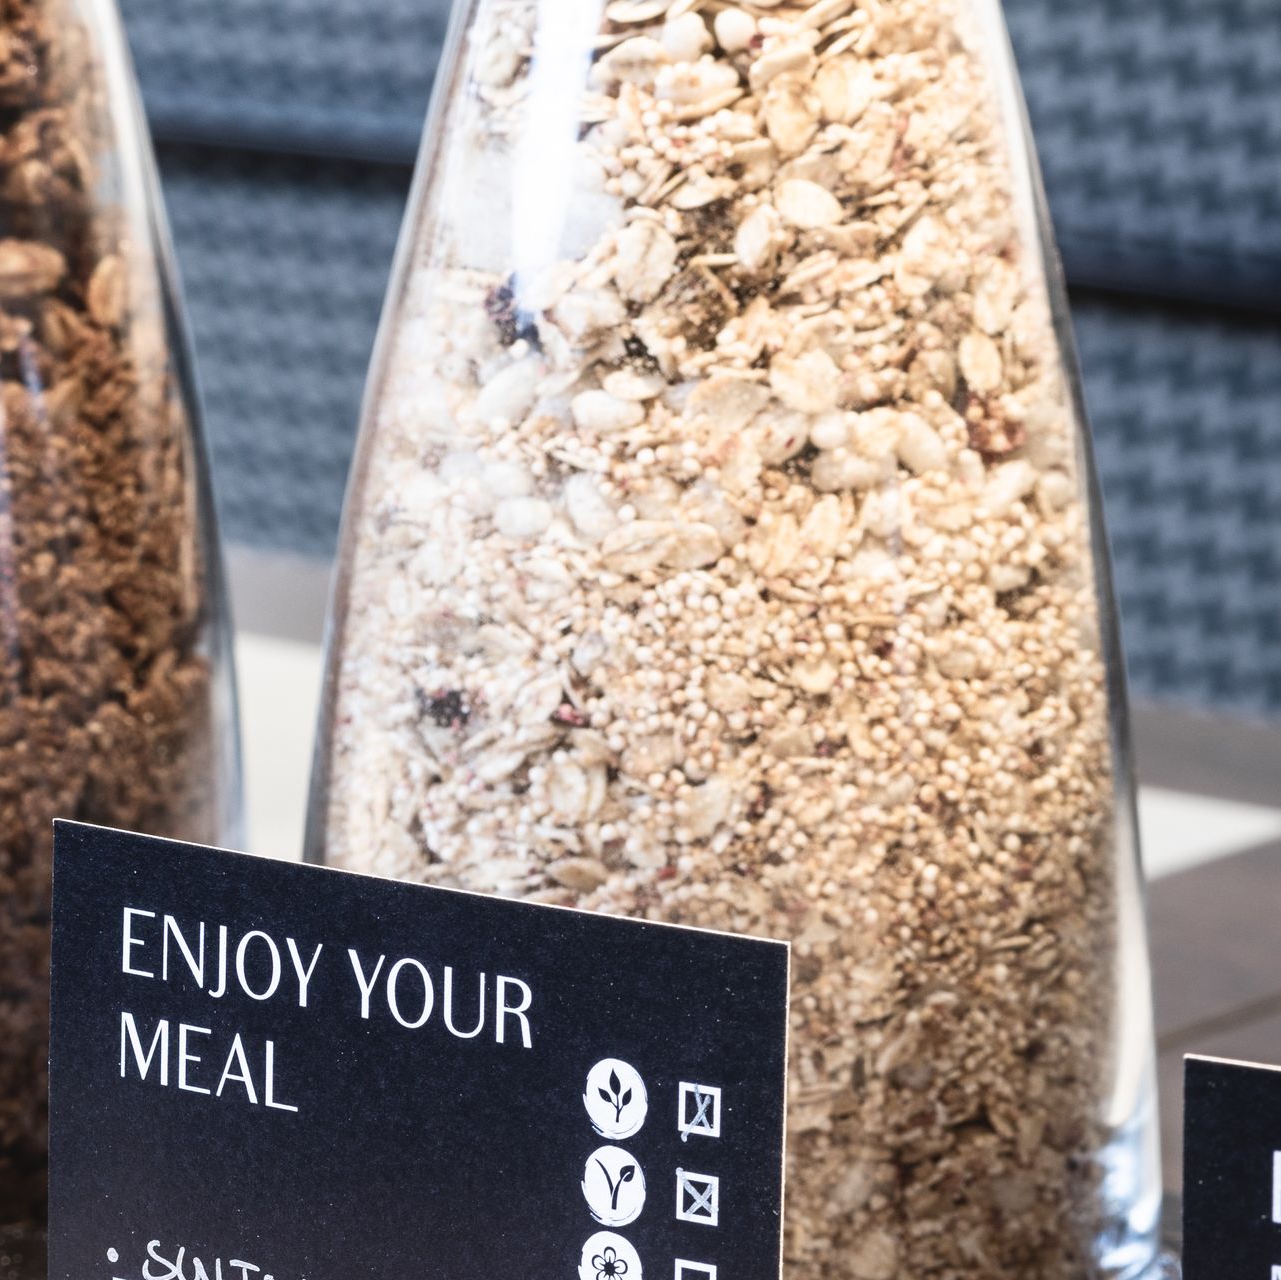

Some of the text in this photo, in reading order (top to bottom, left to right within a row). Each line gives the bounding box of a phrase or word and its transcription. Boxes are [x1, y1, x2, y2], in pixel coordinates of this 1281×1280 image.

[121, 906, 533, 1049] ENJOY YOUR
[119, 1011, 299, 1113] MEAL
